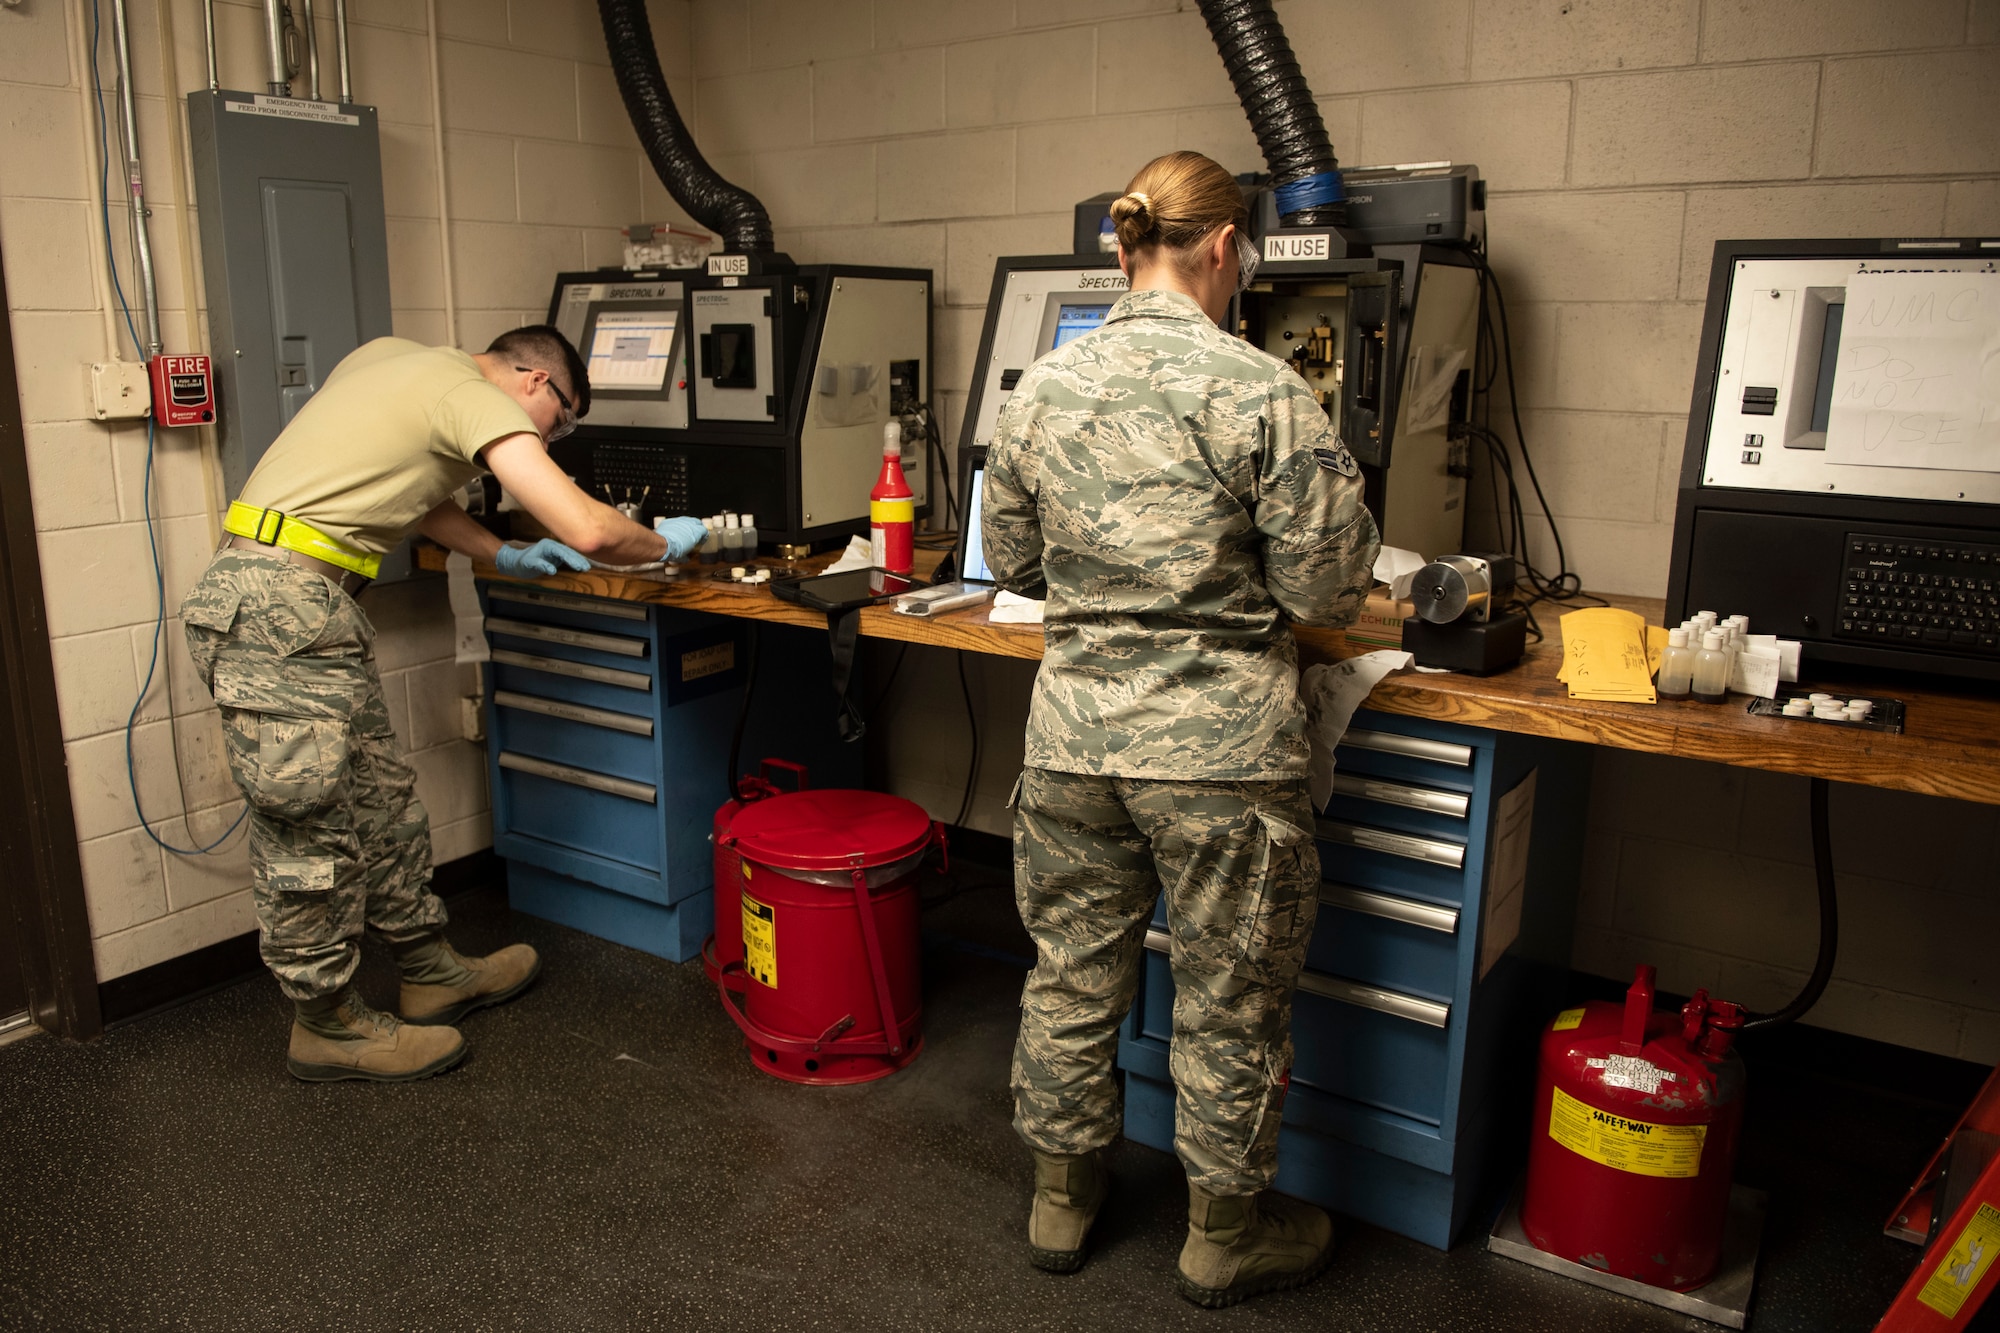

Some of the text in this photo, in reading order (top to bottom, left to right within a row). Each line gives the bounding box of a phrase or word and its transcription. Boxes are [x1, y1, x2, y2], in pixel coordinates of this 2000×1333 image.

[266, 98, 328, 111] EMERGENCY PANEL
[238, 104, 348, 122] FEED FROM DISCONNECT OUTSIDE
[1270, 239, 1325, 256] IN USE
[711, 259, 746, 272] IN USE
[609, 288, 666, 298] SPECTROIL M
[1858, 288, 1980, 327] NMC
[167, 358, 206, 374] FIRE
[1848, 345, 1915, 378] DO
[1840, 374, 1952, 408] NOT
[1361, 614, 1402, 627] ECHLITE
[684, 665, 707, 678] REPAIR
[1610, 1055, 1624, 1064] OIL
[1606, 1076, 1654, 1093] 257-3381
[1629, 1071, 1660, 1084] H1-H8
[1593, 1111, 1652, 1134] SAFE-T-WAY
